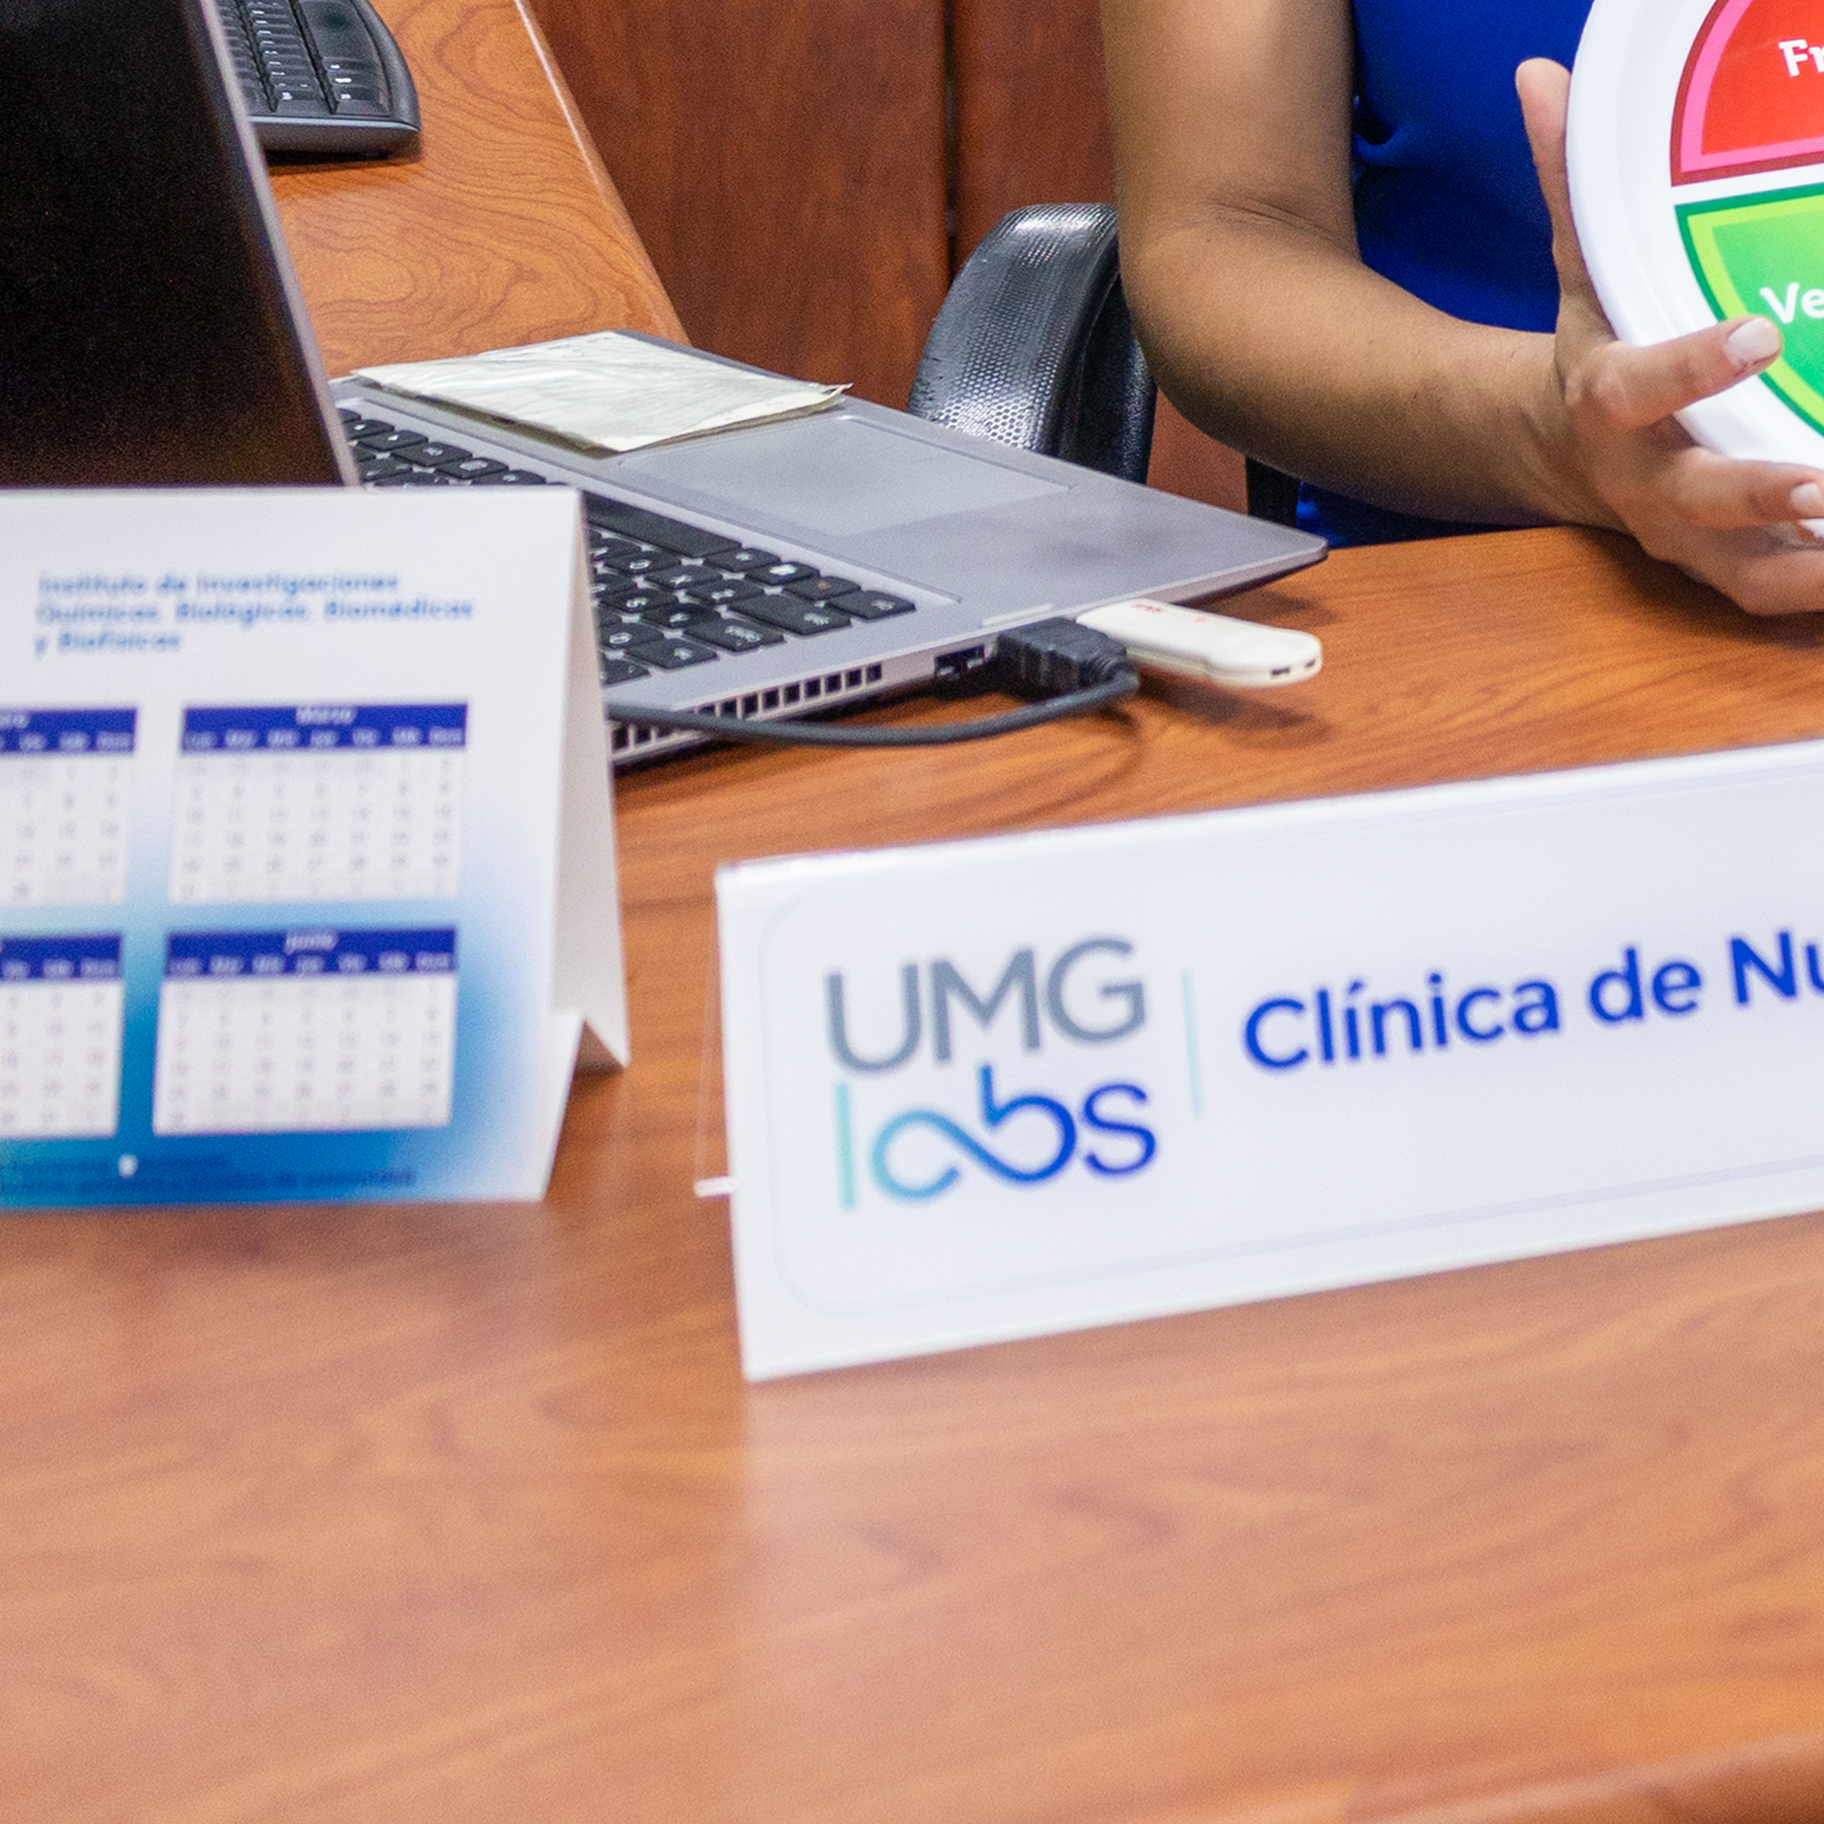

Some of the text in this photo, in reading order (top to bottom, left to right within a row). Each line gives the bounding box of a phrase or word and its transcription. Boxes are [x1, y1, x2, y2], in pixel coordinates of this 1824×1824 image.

[825, 936, 1147, 1076] UMG
[1241, 970, 1563, 1073] Clínica
[1585, 944, 1706, 1028] de
[834, 1063, 1160, 1209] labs
